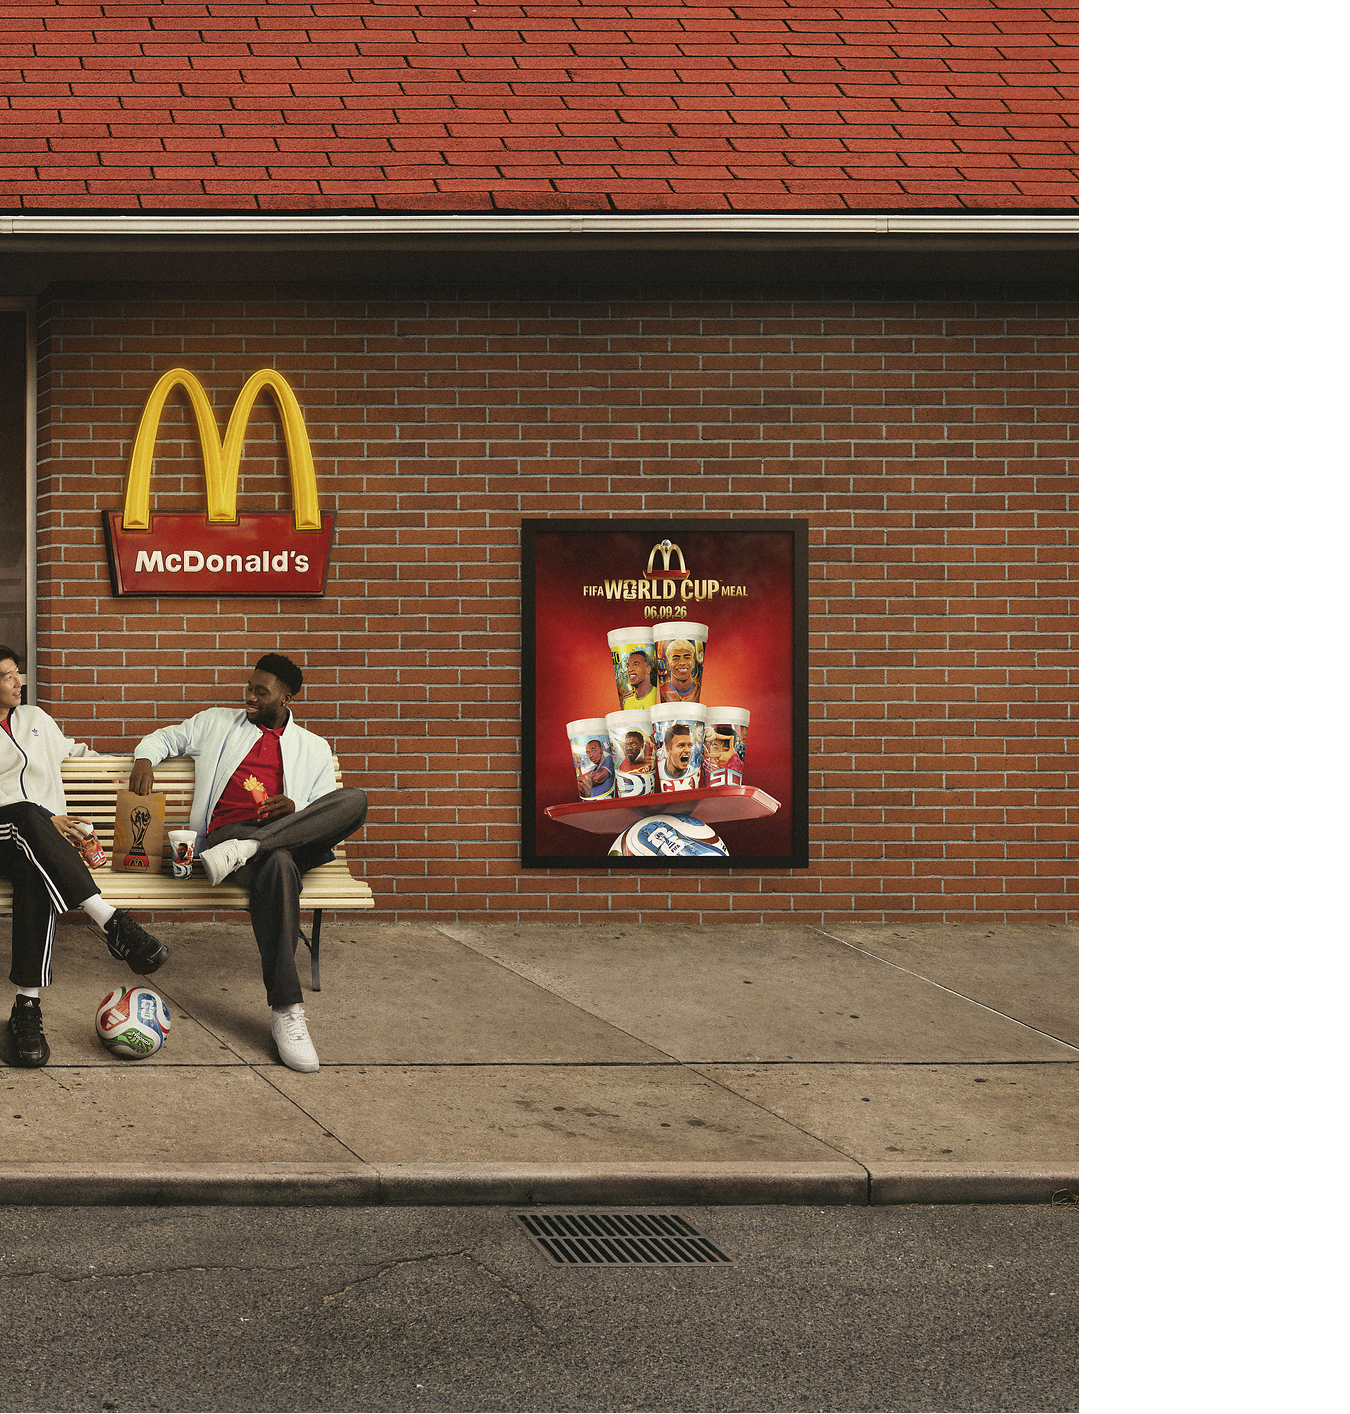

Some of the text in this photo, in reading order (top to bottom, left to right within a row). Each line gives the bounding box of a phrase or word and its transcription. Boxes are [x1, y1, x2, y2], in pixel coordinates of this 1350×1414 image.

[134, 550, 310, 573] McDonald's
[583, 579, 748, 602] FIFA WORLD CUP MEAL
[643, 605, 688, 620] 06.09.26
[670, 843, 682, 854] FIFA
